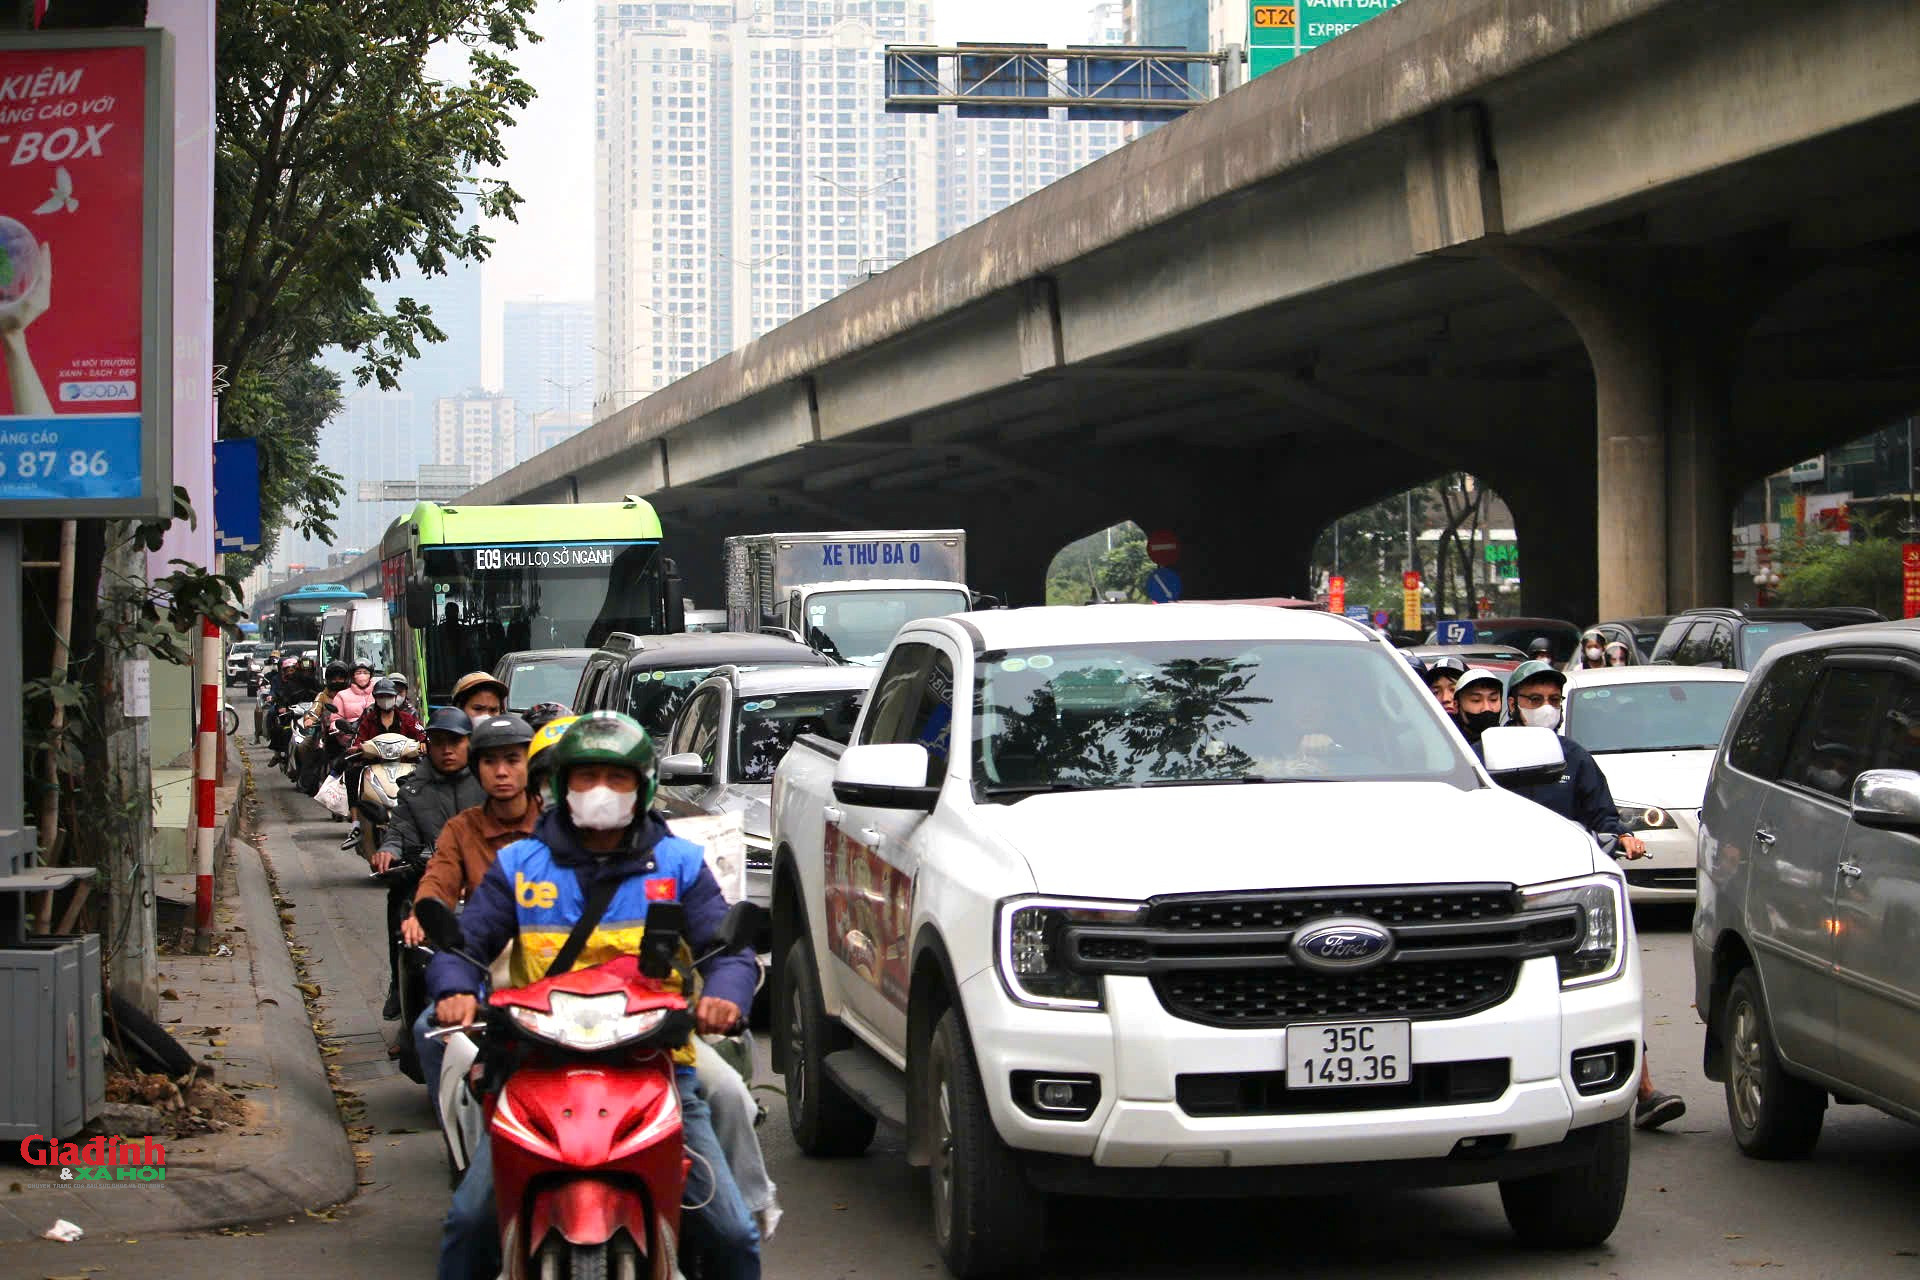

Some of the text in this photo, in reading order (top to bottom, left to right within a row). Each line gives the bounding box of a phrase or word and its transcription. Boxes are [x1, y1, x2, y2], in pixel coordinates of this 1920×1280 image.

[10, 121, 115, 166] BOX
[31, 429, 59, 444] CÁO
[18, 452, 57, 478] 87
[69, 450, 109, 476] 86
[476, 549, 501, 570] E09
[504, 552, 526, 567] KHU
[552, 546, 569, 565] SỞ
[572, 547, 613, 564] NGÀNH
[822, 545, 843, 566] XE
[1447, 623, 1466, 642] G7
[514, 872, 559, 908] be
[1320, 935, 1370, 956] Ford
[1323, 1027, 1374, 1053] 35C
[1304, 1055, 1396, 1084] 149.36
